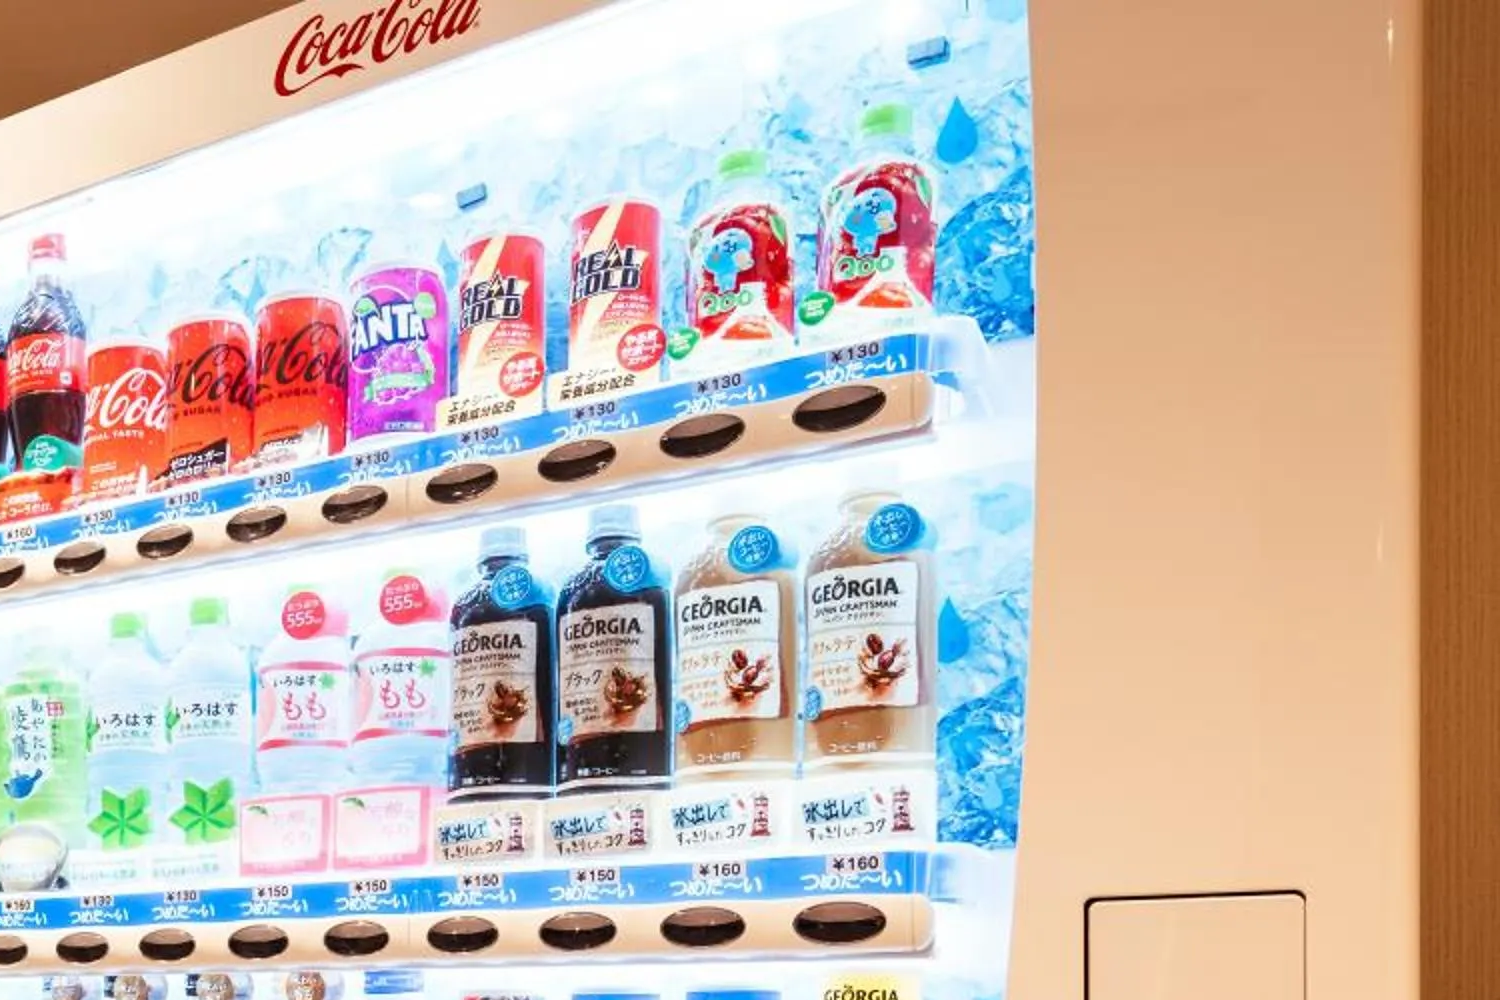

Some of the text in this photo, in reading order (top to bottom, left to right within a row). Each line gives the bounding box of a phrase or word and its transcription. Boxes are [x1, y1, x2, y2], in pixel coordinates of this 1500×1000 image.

[274, 0, 481, 96] Coca-Cola
[575, 240, 642, 274] REAL
[460, 272, 523, 307] REAL
[571, 264, 642, 304] GOLD
[460, 295, 523, 334] GOLD
[352, 302, 428, 358] ANTA
[830, 341, 880, 364] ¥130
[698, 372, 741, 394] ¥130
[574, 401, 616, 420] ¥130
[460, 425, 500, 444] ¥130
[380, 678, 426, 708] もも
[175, 701, 239, 719] いろはす
[283, 692, 327, 720] もも
[699, 862, 741, 877] ¥160
[832, 855, 880, 871] ¥160
[463, 873, 499, 887] ¥150
[577, 869, 615, 883] ¥150
[166, 890, 197, 903] ¥130
[257, 886, 289, 898] ¥150
[354, 880, 388, 893] ¥150
